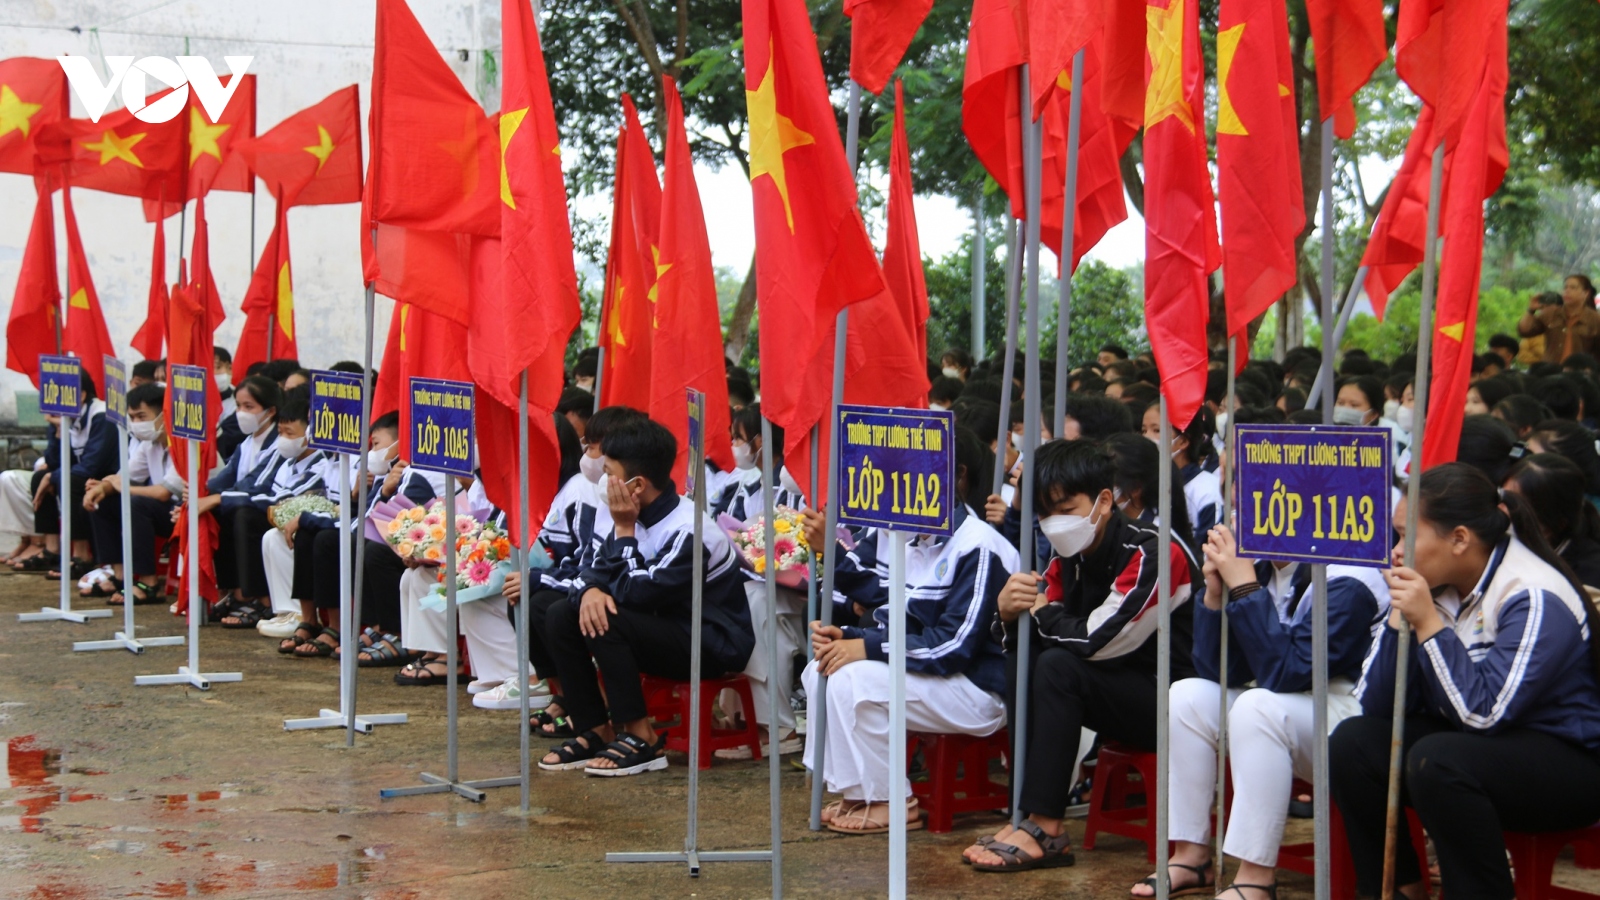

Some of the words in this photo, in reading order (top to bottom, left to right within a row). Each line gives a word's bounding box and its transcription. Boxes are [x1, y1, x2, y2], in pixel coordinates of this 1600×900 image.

[431, 392, 441, 406] THPT
[314, 402, 335, 440] LỚP
[338, 413, 360, 444] 10A4
[417, 415, 440, 455] LỚP
[443, 426, 469, 461] 10A5
[847, 419, 872, 446] TRƯỜNG
[872, 425, 887, 447] THPT
[910, 422, 923, 450] THẾ
[924, 429, 942, 452] VINH
[1245, 438, 1282, 464] TRƯỜNG
[1283, 444, 1306, 465] THPT
[1308, 441, 1338, 466] LƯƠNG
[1339, 438, 1358, 467] THẾ
[1360, 446, 1382, 468] VINH
[847, 454, 884, 511] LỚP
[891, 471, 940, 518] 11A2
[1253, 478, 1303, 537] LỚP
[1312, 494, 1375, 542] 11A3
